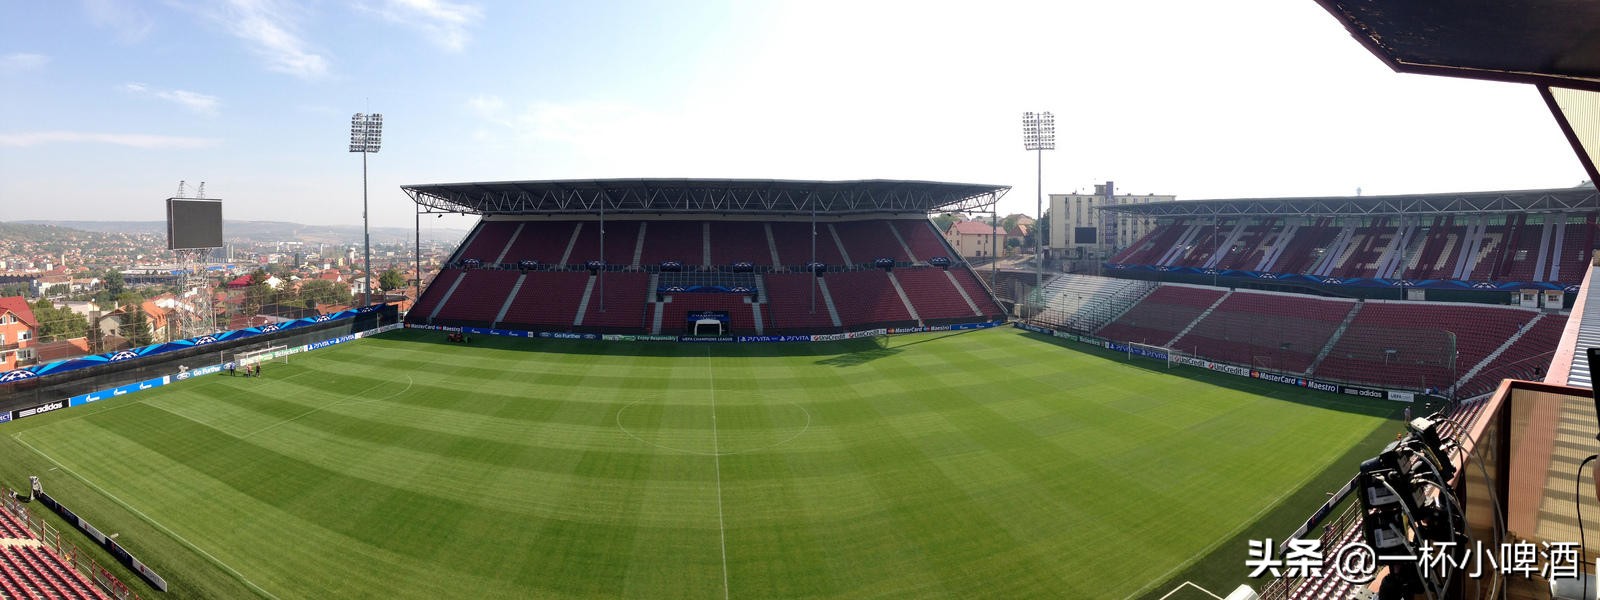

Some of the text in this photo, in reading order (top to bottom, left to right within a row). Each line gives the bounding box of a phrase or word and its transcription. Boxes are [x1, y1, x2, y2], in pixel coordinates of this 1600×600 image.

[193, 369, 202, 377] Go
[202, 366, 220, 375] Further
[1214, 363, 1242, 374] UniCredit
[1260, 371, 1336, 392] MasterCard Maestro
[1359, 389, 1382, 398] adidas
[36, 402, 63, 413] adidas
